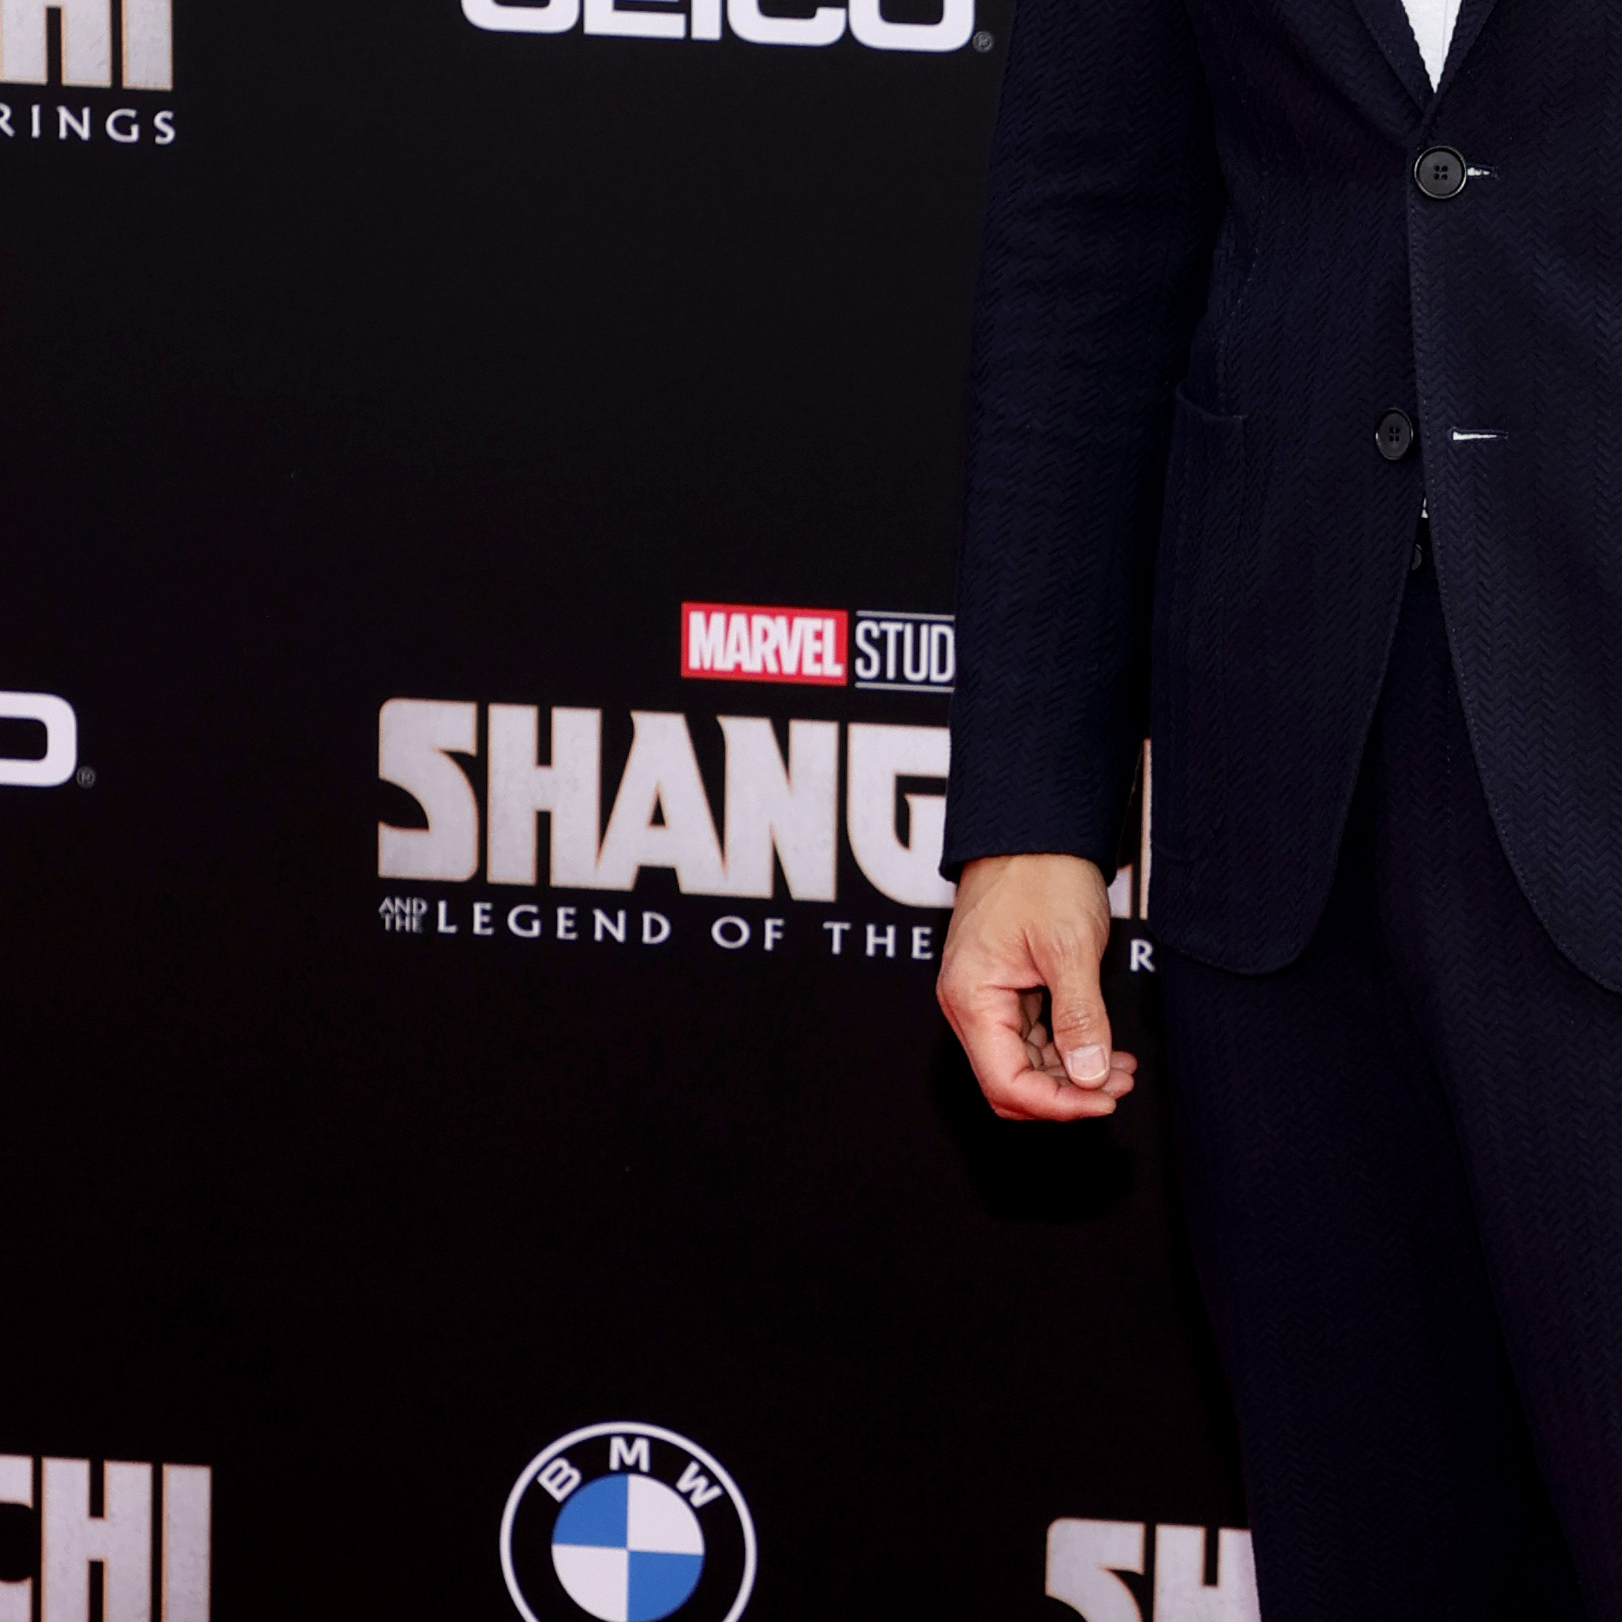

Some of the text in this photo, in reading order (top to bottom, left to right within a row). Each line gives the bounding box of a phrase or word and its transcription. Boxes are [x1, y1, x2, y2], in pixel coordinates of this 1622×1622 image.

[687, 610, 956, 683] MARVEL STUD
[378, 699, 957, 909] SHANG
[378, 896, 428, 916] AND
[437, 900, 934, 960] LEGEND OF THE
[537, 1436, 722, 1508] BMW
